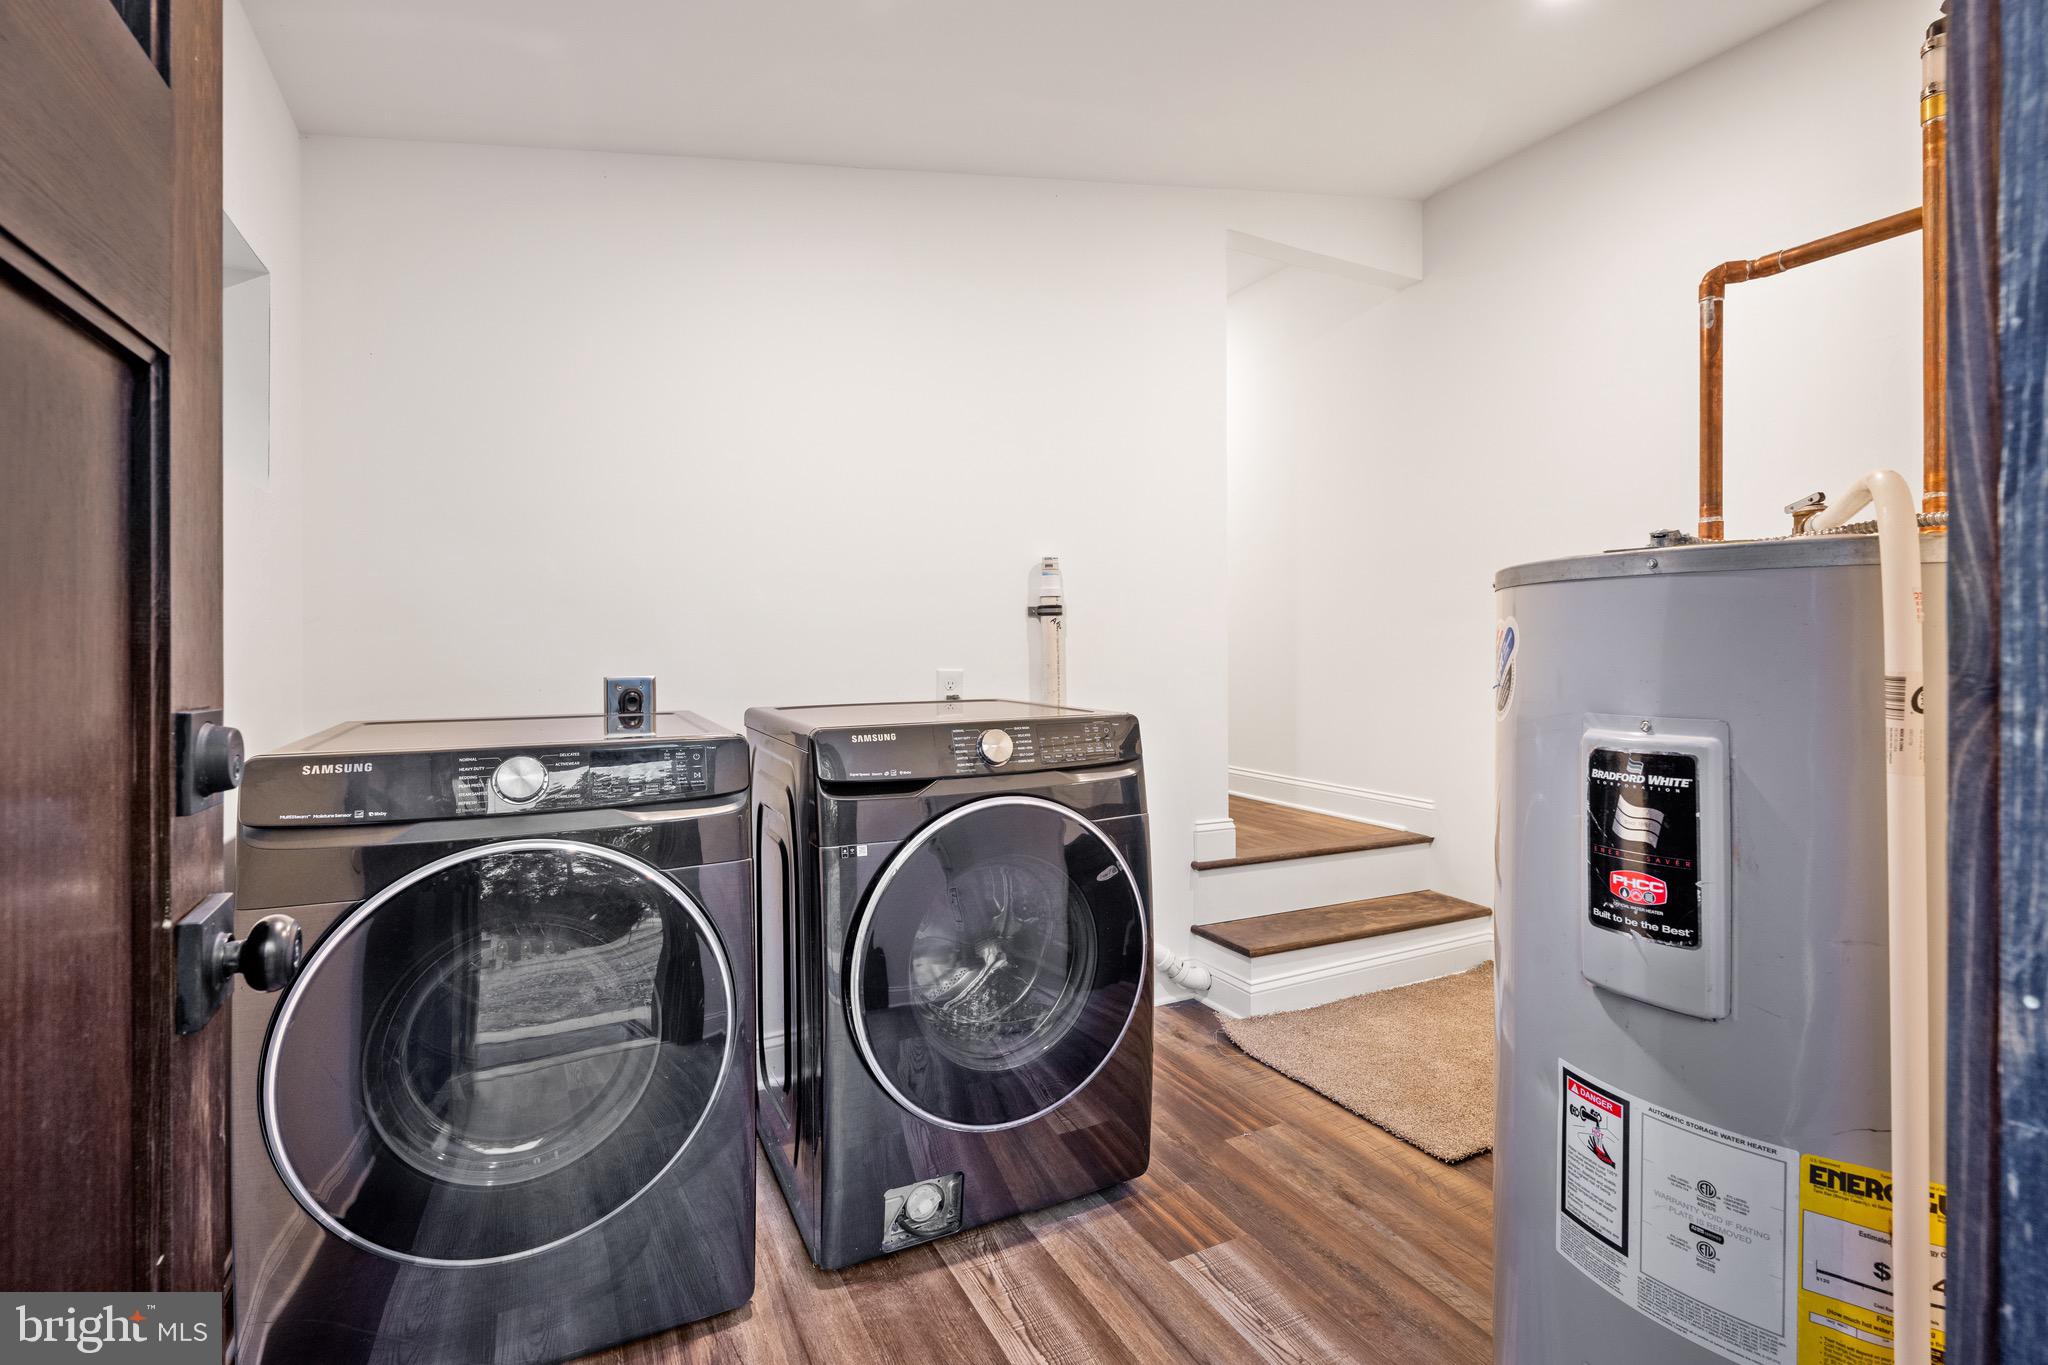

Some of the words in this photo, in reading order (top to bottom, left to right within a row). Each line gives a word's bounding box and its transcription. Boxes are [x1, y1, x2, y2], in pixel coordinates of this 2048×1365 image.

[851, 733, 897, 743] SAMSUNG
[302, 762, 373, 775] SAMSUNG
[1591, 768, 1646, 784] BRADFORD
[1596, 780, 1681, 793] CORPORATION
[1646, 857, 1691, 868] SAVER
[1612, 874, 1665, 893] PHCC
[1593, 907, 1611, 920] Built
[1612, 913, 1622, 922] to
[1624, 917, 1638, 926] be
[1640, 920, 1659, 931] the
[1579, 1087, 1613, 1110] DANGER
[1648, 1106, 1684, 1125] AUTOMATIC
[1685, 1120, 1719, 1137] STORAGE
[1719, 1132, 1746, 1146] WATER
[1747, 1141, 1778, 1155] HEATER
[1654, 1189, 1700, 1214] WARRANTY
[1701, 1210, 1723, 1224] VOID
[1725, 1219, 1734, 1227] IF
[1735, 1223, 1771, 1241] RATING
[1668, 1205, 1694, 1220] PLATE
[1696, 1217, 1705, 1226] IS
[1706, 1220, 1752, 1245] REMOVED
[1858, 1230, 1892, 1246] Estimated
[1872, 1262, 1892, 1282] $
